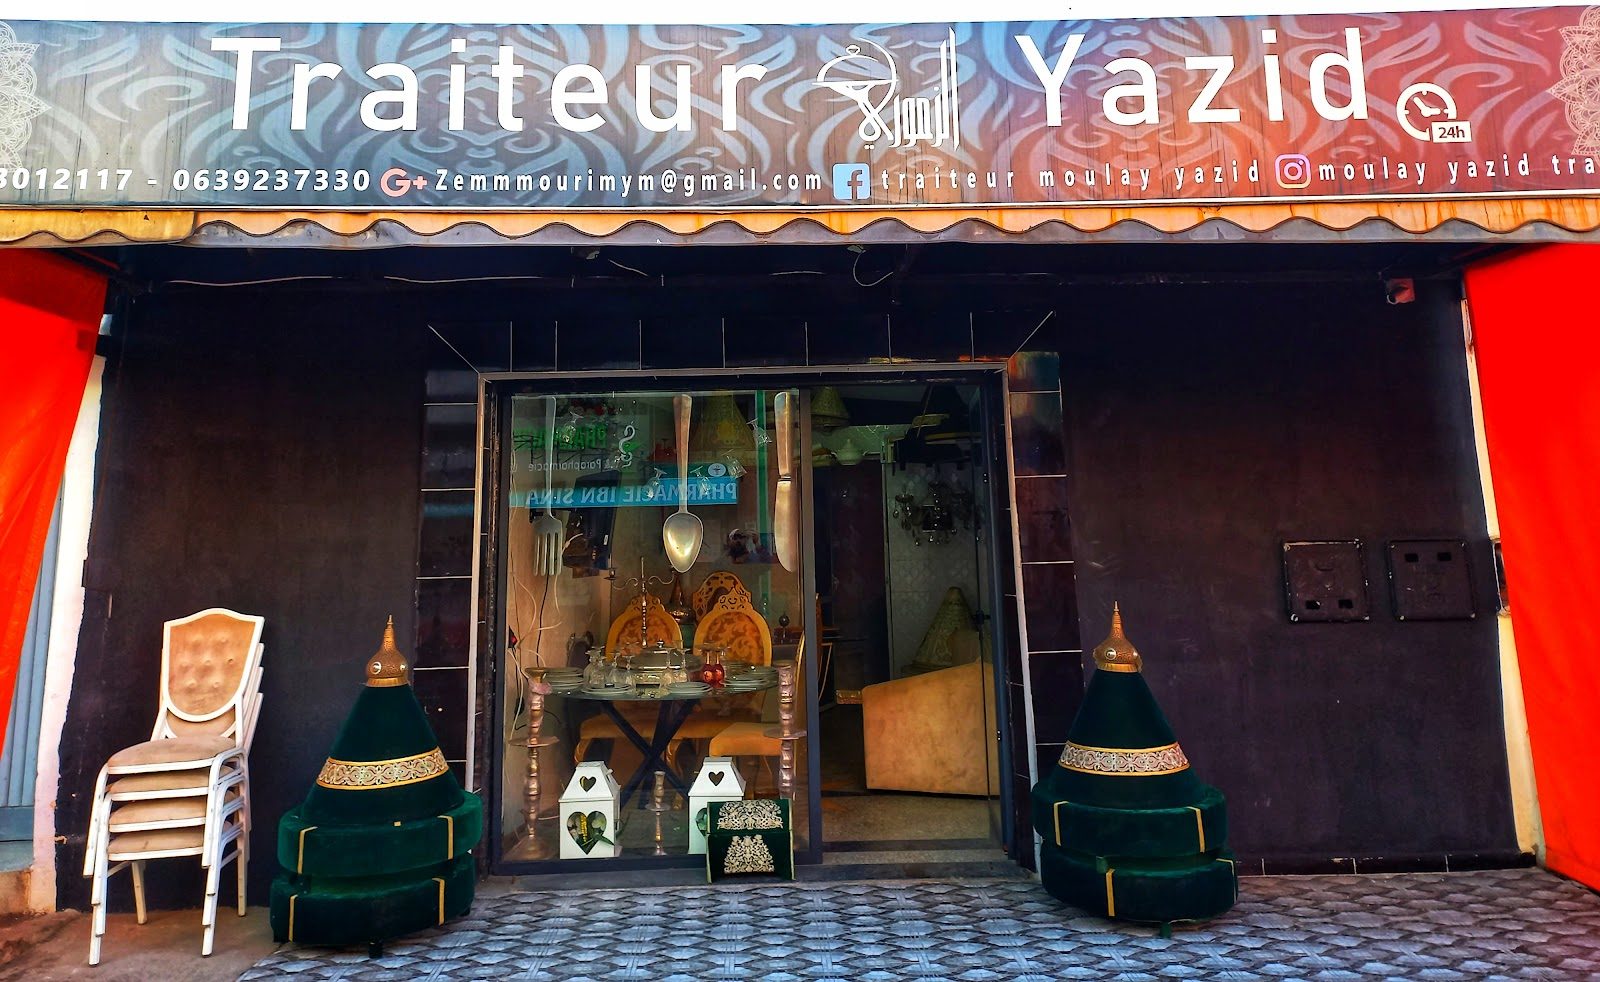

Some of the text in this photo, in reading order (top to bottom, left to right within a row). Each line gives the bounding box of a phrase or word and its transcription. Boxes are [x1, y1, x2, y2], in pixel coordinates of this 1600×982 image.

[210, 27, 1369, 133] Traiteur Yazid
[1438, 126, 1466, 139] 24h
[172, 168, 371, 192] 0639237330
[435, 167, 822, 198] Zemmmourimym@gmail.com
[881, 159, 1259, 191] traiteur moulay yazid
[1318, 153, 1595, 186] moulay yazid tra
